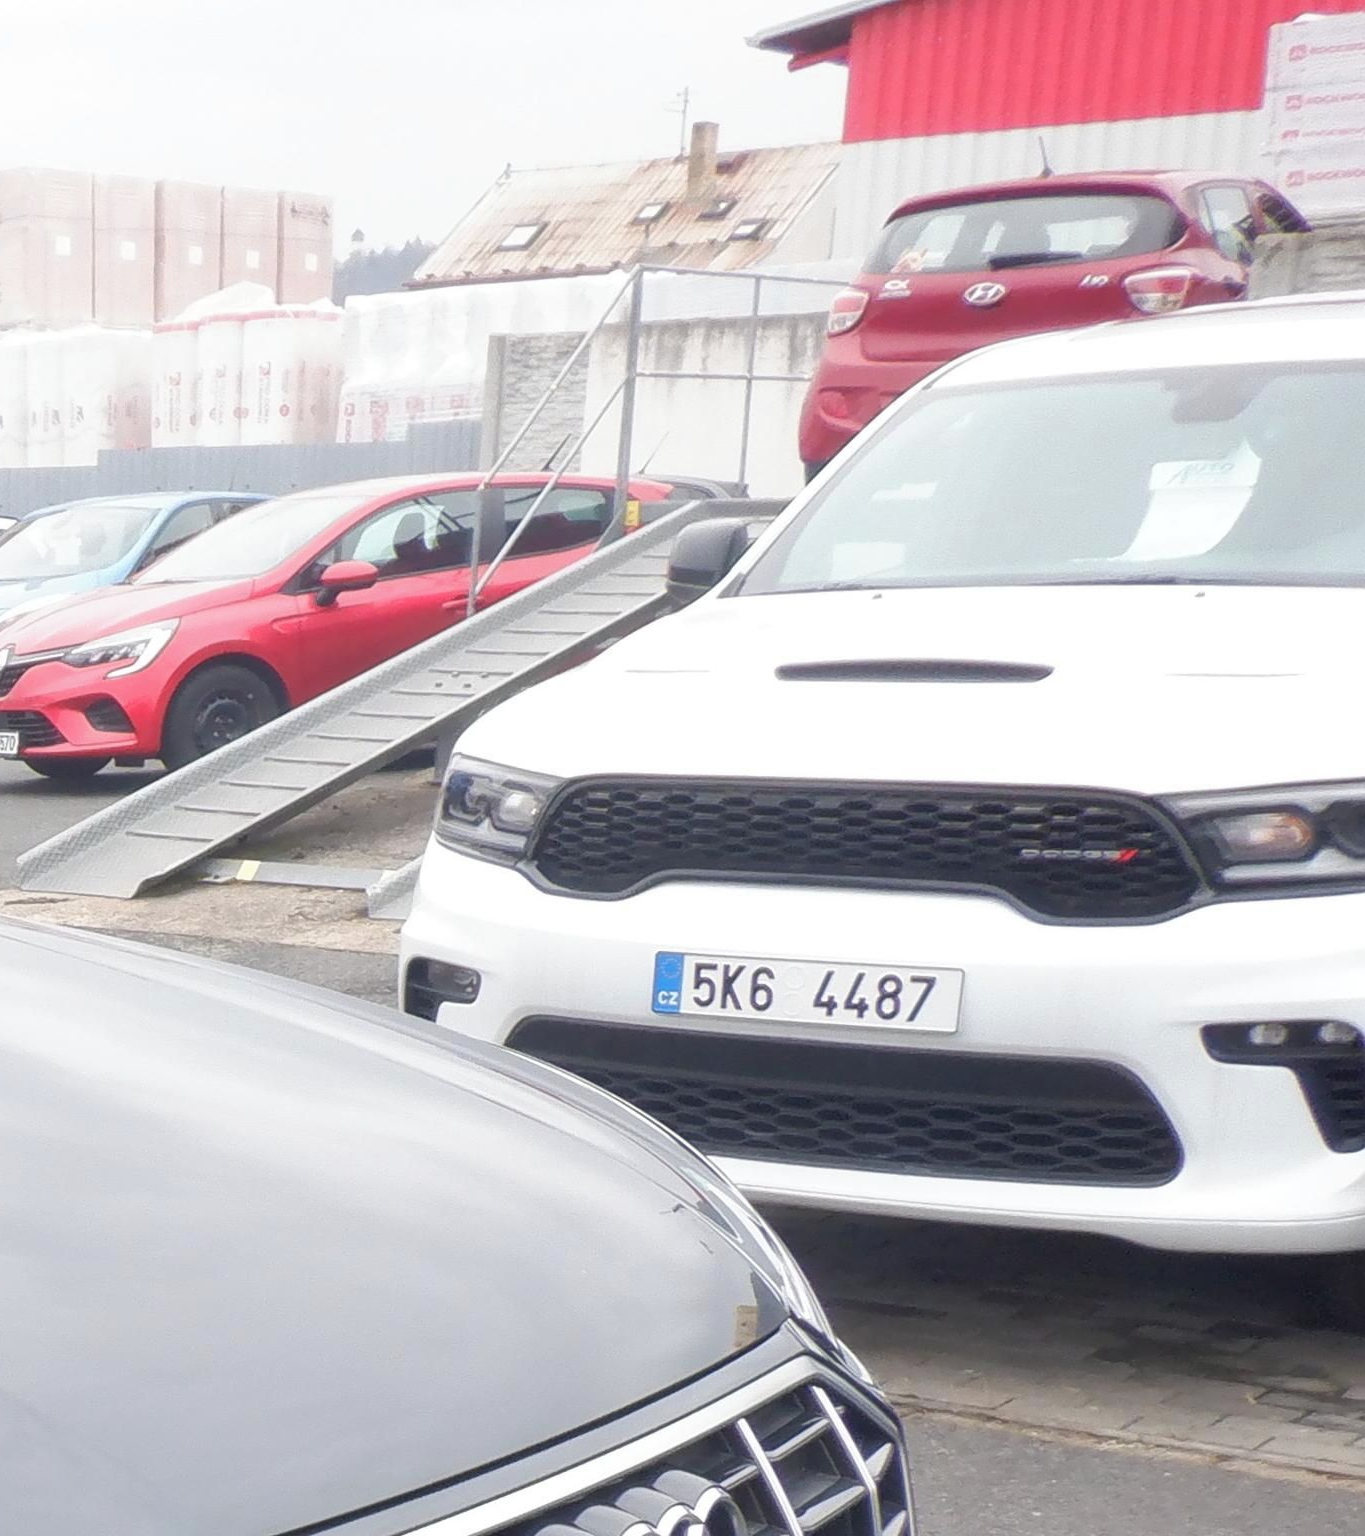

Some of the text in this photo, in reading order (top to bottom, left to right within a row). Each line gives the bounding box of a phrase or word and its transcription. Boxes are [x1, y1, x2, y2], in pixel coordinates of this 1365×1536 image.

[658, 990, 679, 1006] CZ
[692, 962, 937, 1023] 5K6 4487
